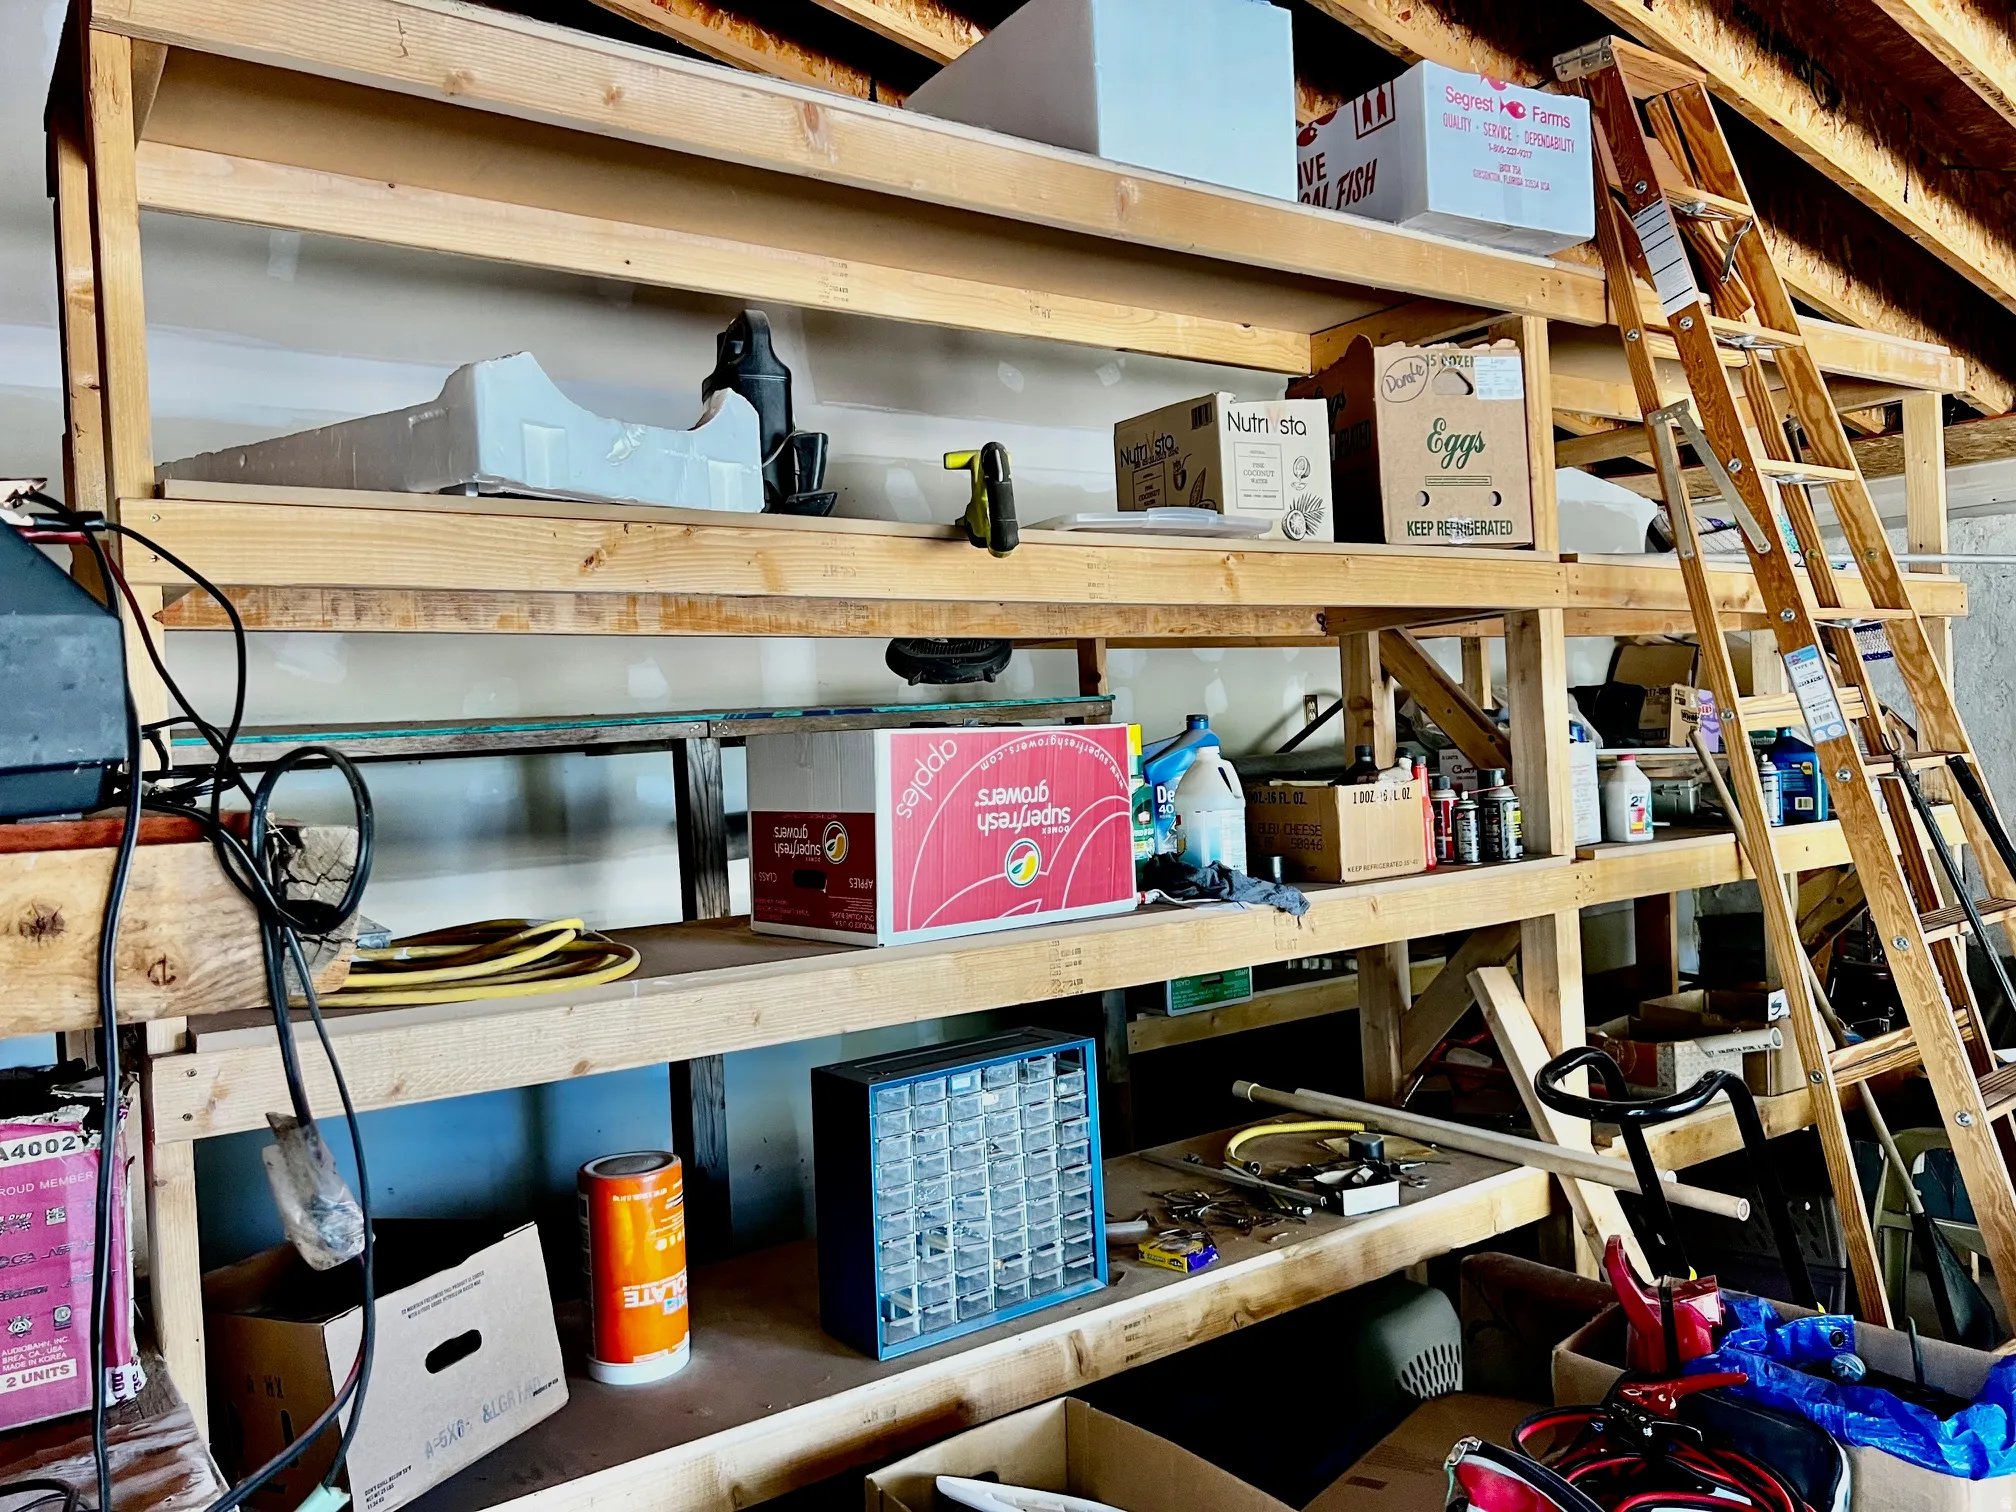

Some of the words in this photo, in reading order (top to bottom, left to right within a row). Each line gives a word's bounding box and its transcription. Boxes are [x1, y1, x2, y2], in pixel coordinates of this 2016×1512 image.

[1446, 86, 1494, 112] Segrest
[1532, 106, 1570, 128] Farms
[1443, 113, 1471, 132] QUALITY
[1484, 122, 1512, 140] SERVICE
[1525, 130, 1575, 153] DEPENDABILITY
[1297, 152, 1326, 190] IVE
[1336, 158, 1378, 210] FISH
[1426, 418, 1486, 469] Eggs
[1407, 520, 1434, 536] KEEP
[1437, 520, 1513, 536] REFRIGERATED
[980, 734, 1124, 790] www.superfreshgrowers.com
[897, 740, 958, 819] apples
[978, 803, 1070, 836] superfresh
[774, 824, 808, 839] growers
[1042, 826, 1070, 835] DOMEX
[1258, 823, 1279, 834] BLEU
[1284, 824, 1322, 836] CHEESE
[774, 840, 821, 859] superfresh
[1364, 861, 1403, 870] REFRIGERATED
[759, 872, 778, 882] CLASS
[849, 878, 873, 889] APPLES
[0, 1183, 34, 1197] ROUD
[40, 1170, 94, 1189] MEMBER
[454, 1280, 467, 1290] PRODUCT
[2, 1340, 52, 1355] AUDIOBAHN,
[49, 1345, 64, 1354] USA
[3, 1361, 27, 1371] MADE
[38, 1353, 67, 1363] KOREA
[6, 1377, 16, 1388] 2
[22, 1365, 70, 1384] UNITS
[378, 1479, 387, 1489] CHILL
